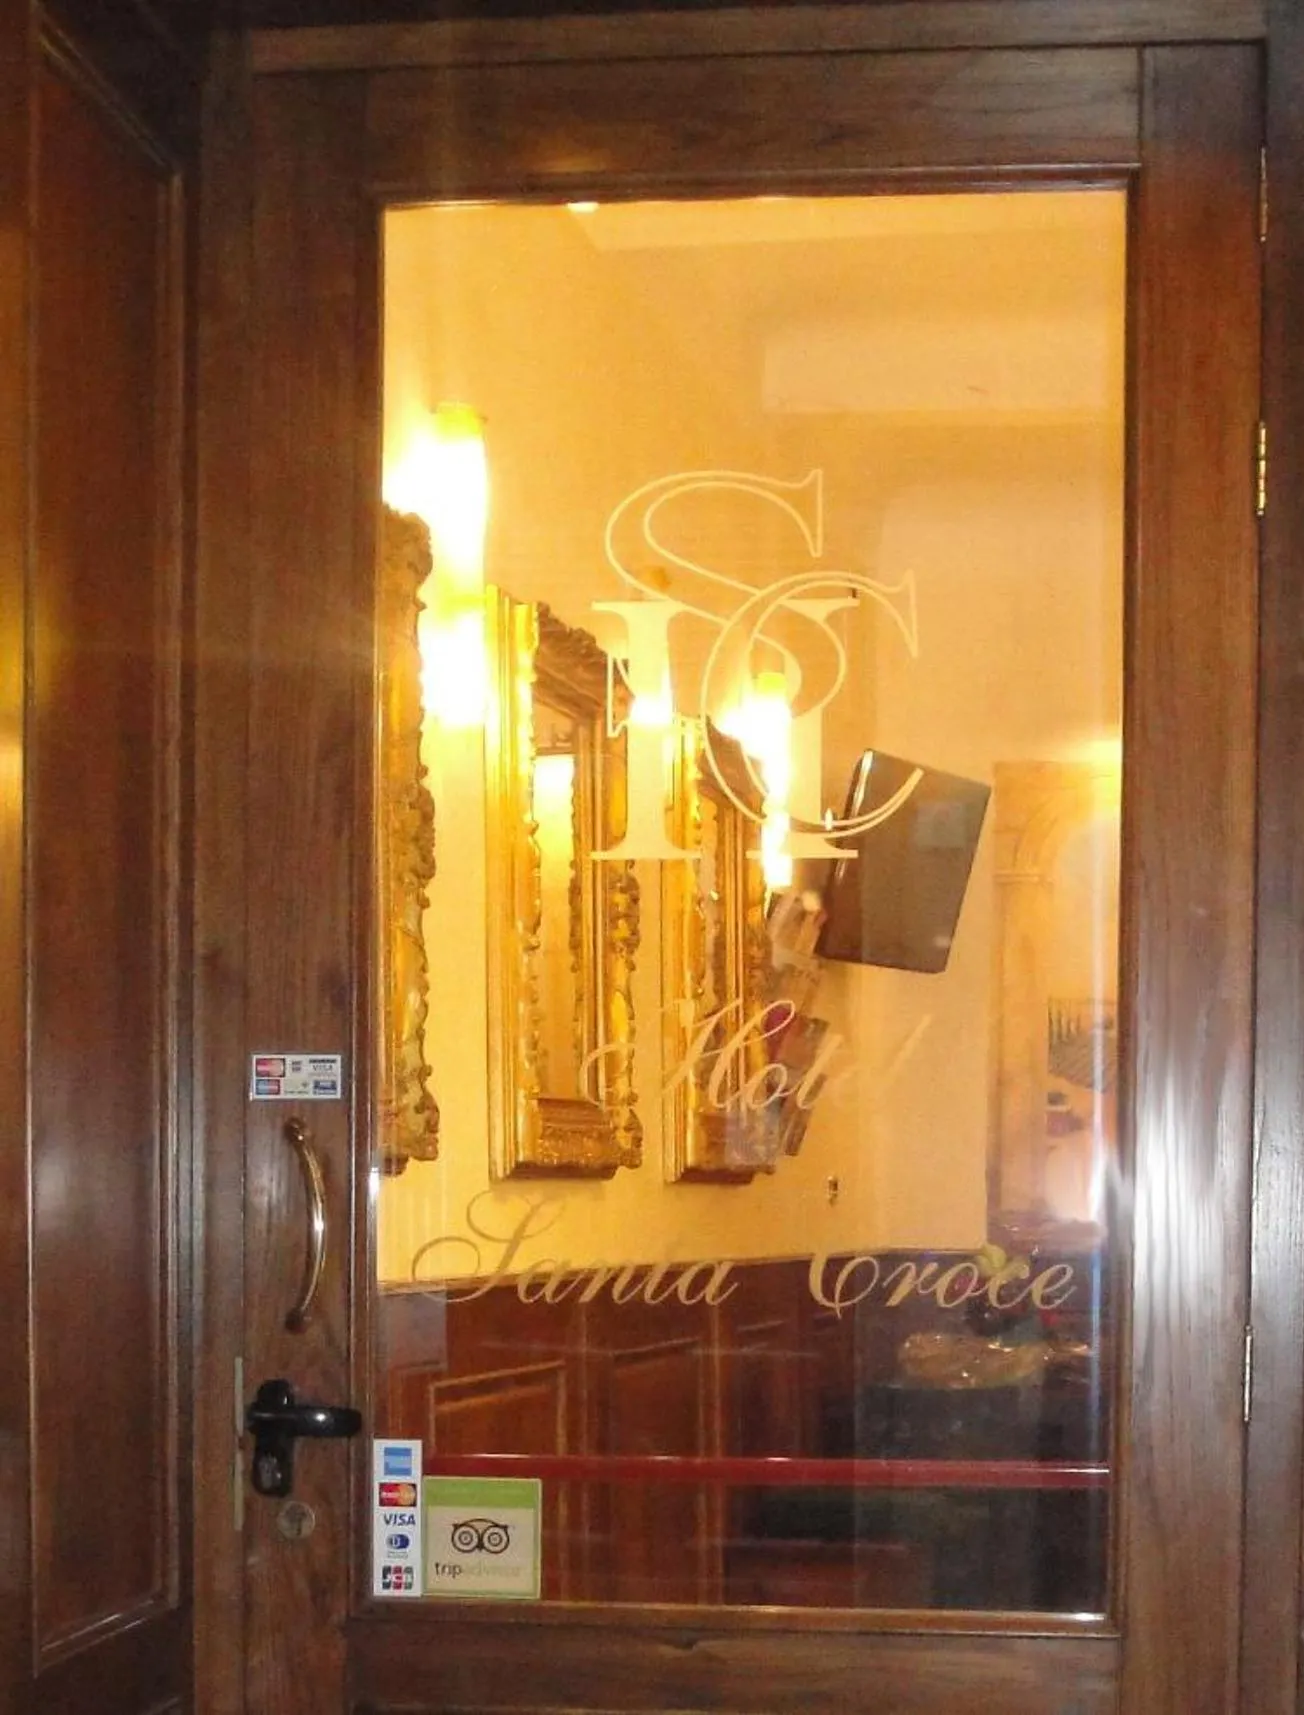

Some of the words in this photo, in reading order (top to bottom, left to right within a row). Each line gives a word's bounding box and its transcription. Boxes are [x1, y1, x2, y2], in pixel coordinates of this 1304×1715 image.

[411, 1189, 739, 1306] Santa
[808, 1246, 1078, 1320] Croce
[383, 1513, 416, 1526] VISA
